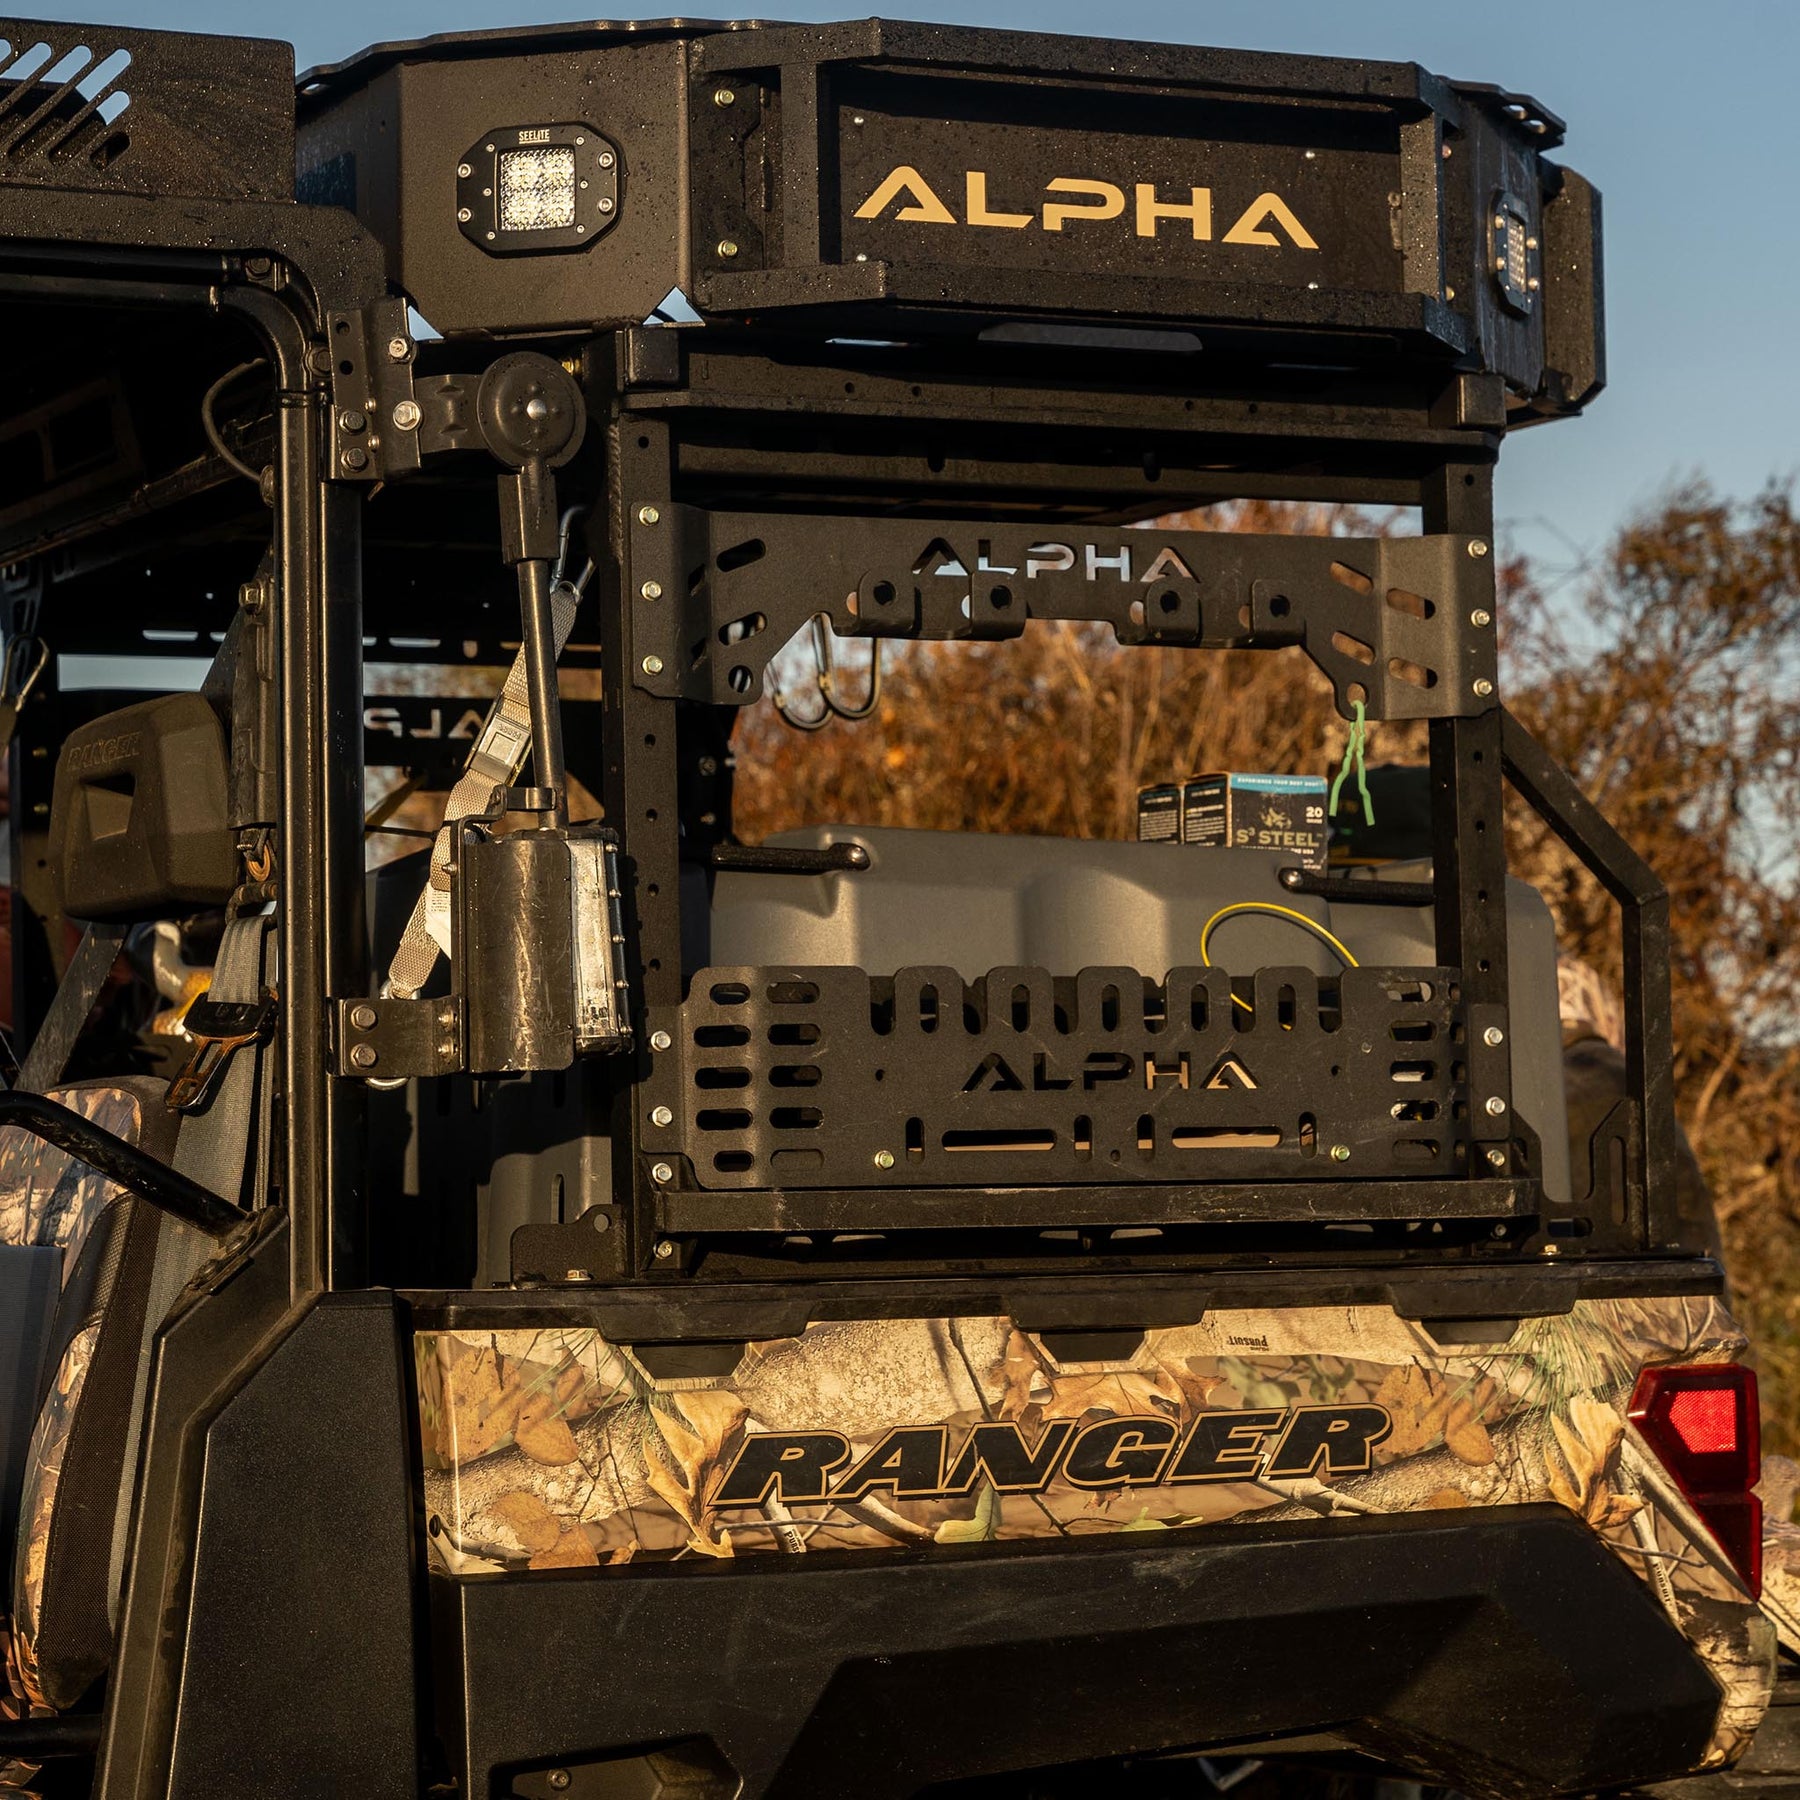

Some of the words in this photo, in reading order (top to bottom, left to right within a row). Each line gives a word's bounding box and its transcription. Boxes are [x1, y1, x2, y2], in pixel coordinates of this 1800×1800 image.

[854, 166, 1318, 249] ALPHA
[912, 537, 1199, 583] ALPHA
[1306, 806, 1323, 817] 20
[962, 1051, 1258, 1091] ALPHA
[1228, 1335, 1269, 1347] PURSUIT
[708, 1403, 1393, 1508] RANGER
